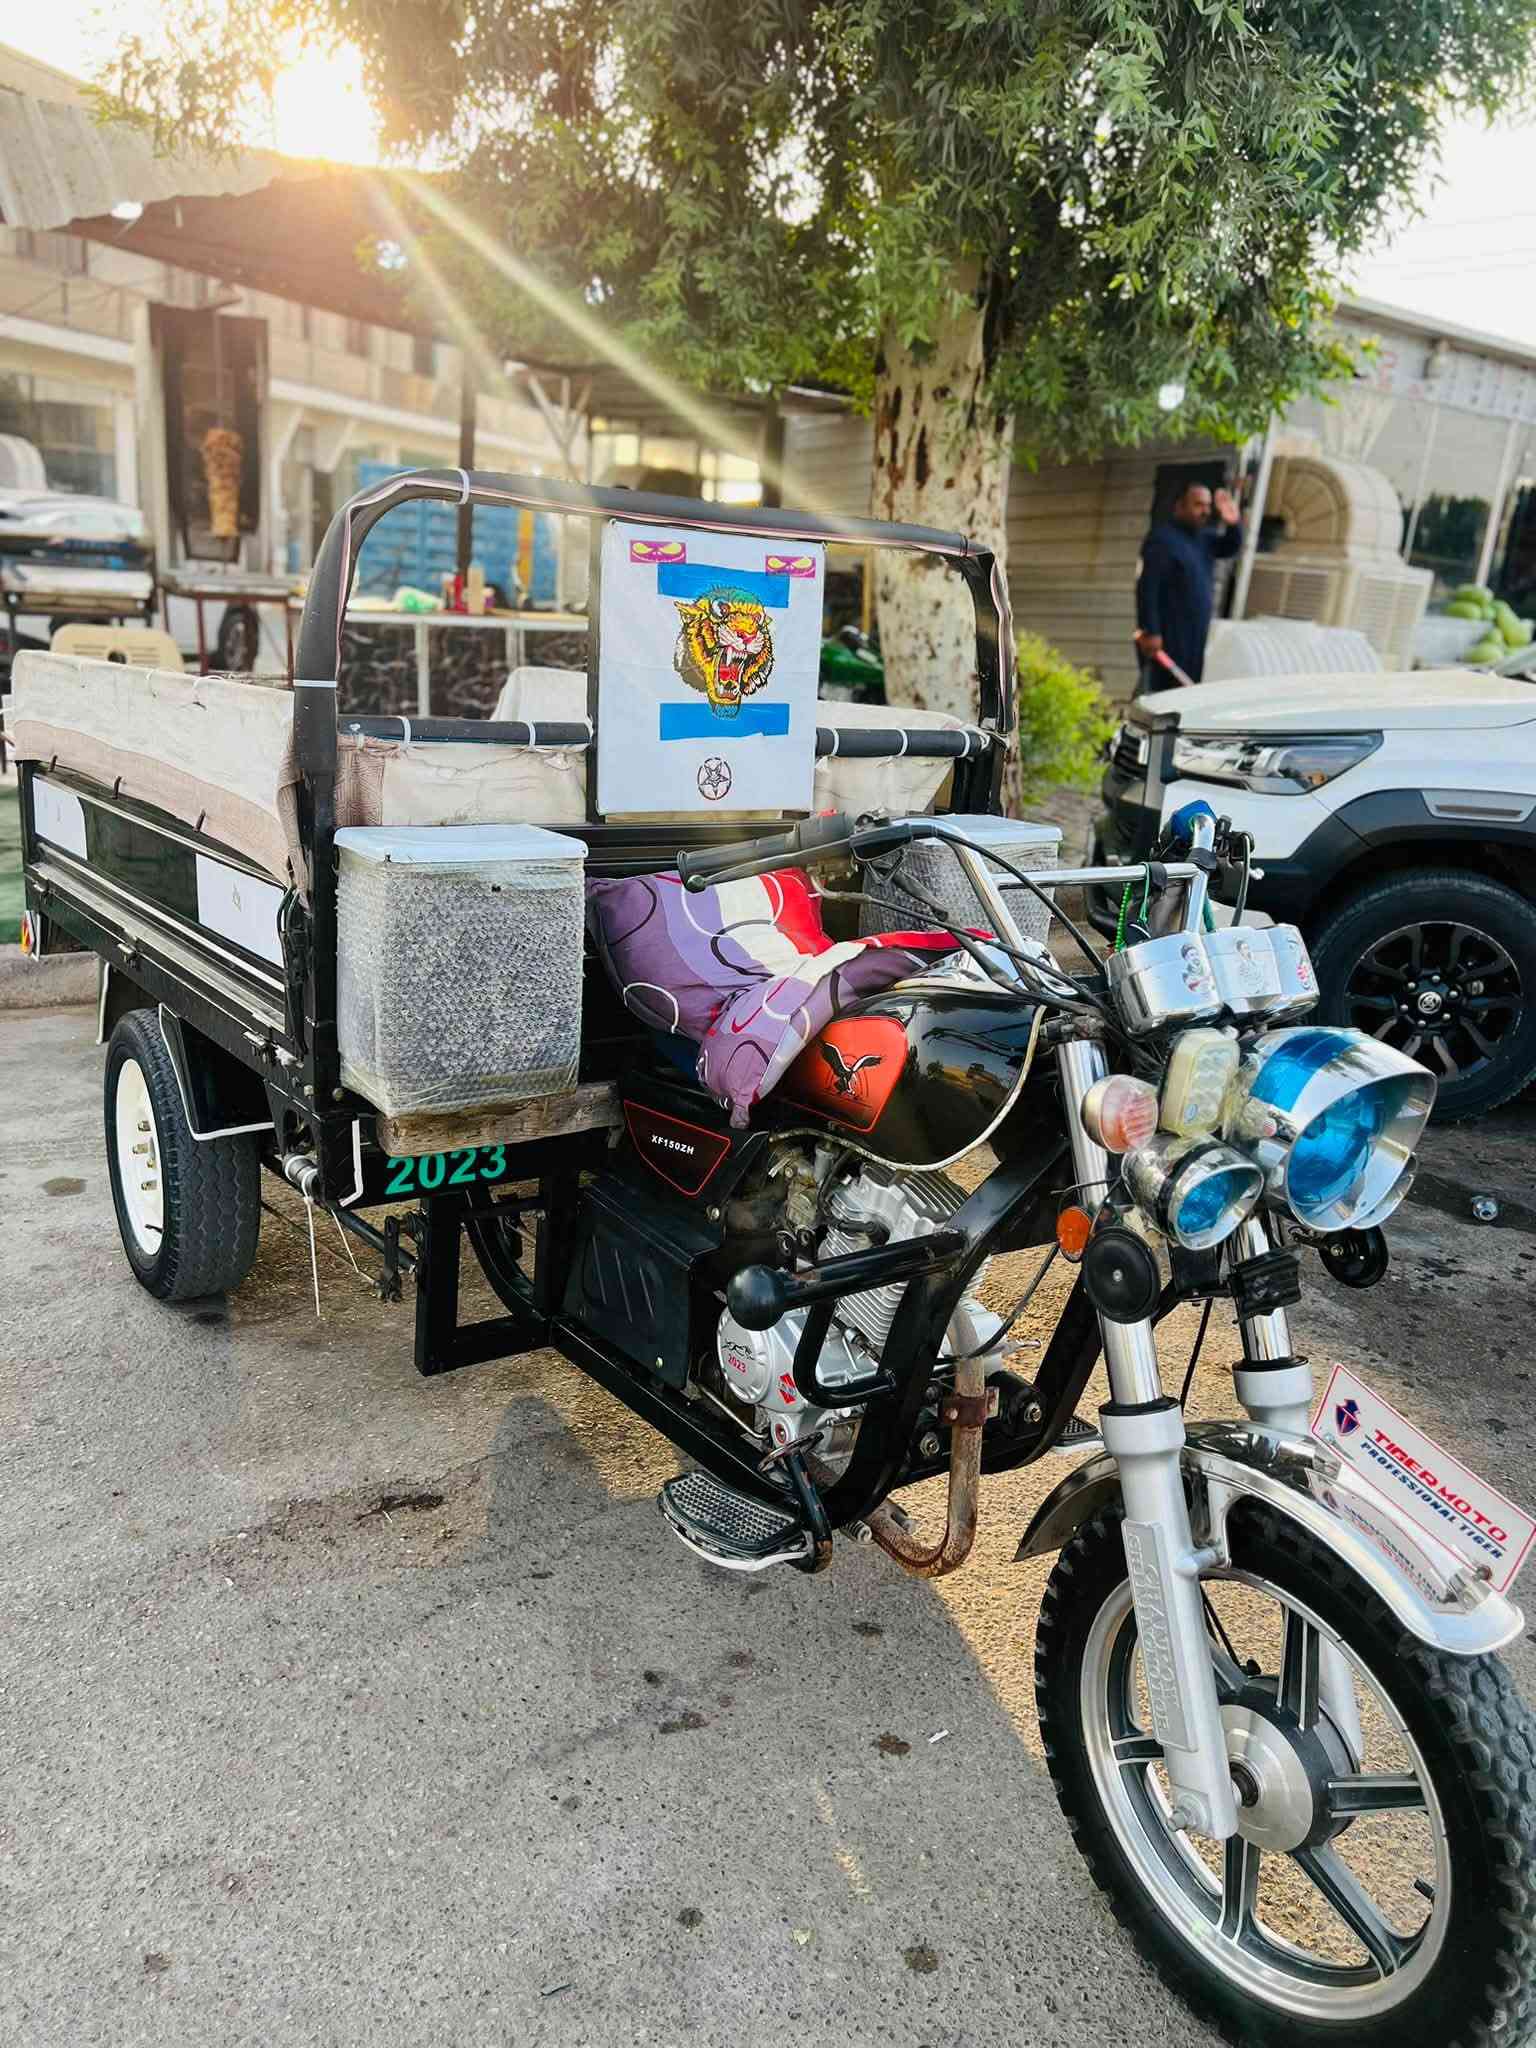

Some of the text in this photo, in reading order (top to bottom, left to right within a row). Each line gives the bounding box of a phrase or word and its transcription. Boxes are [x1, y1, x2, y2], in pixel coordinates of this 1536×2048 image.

[651, 1134, 695, 1155] XF150ZH
[384, 1143, 507, 1195] 2023
[728, 1353, 747, 1374] 2023
[1360, 1441, 1457, 1523] PROFESSIONAL
[1459, 1523, 1503, 1559] TIGER
